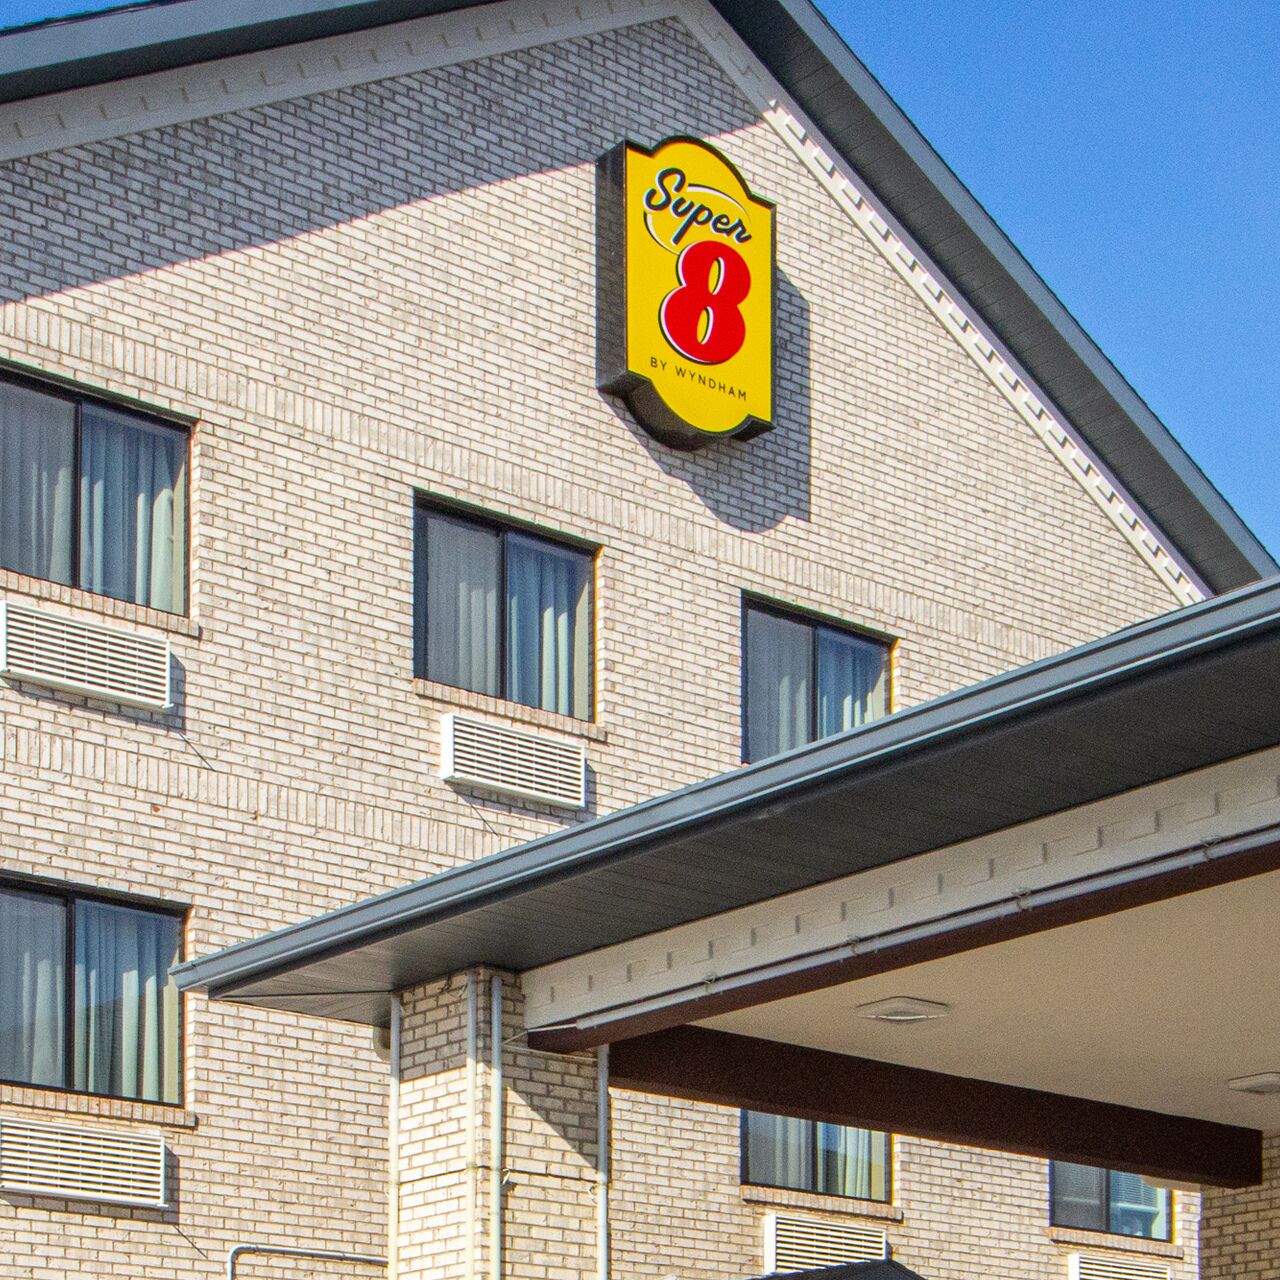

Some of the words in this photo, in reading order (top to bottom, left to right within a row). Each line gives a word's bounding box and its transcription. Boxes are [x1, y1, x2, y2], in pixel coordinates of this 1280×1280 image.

[642, 167, 753, 246] Super
[658, 240, 751, 366] 8
[650, 356, 668, 371] BY
[675, 365, 747, 402] WYNDHAM
